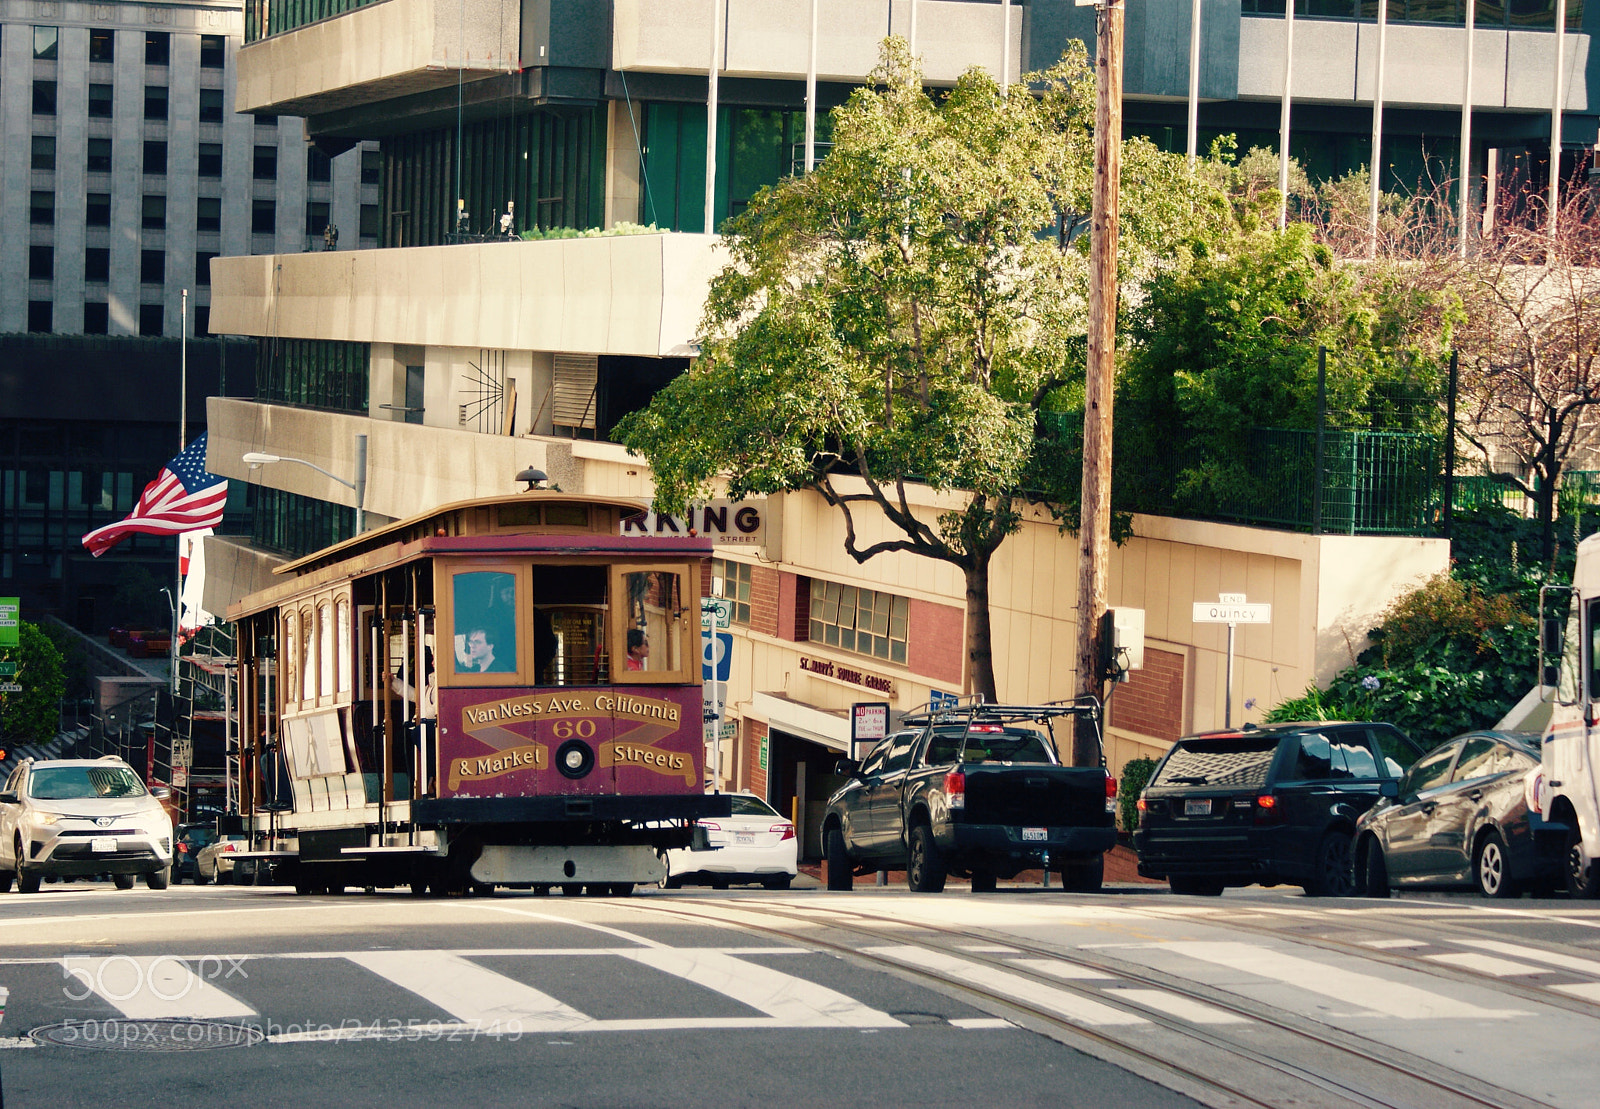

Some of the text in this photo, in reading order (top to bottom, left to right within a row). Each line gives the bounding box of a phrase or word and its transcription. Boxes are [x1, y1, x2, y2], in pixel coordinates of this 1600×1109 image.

[624, 507, 760, 533] RKING
[1209, 608, 1256, 619] Quincy
[837, 667, 862, 685] SQUARE
[865, 674, 892, 693] GARAGE
[466, 706, 499, 725] Van
[500, 699, 543, 719] Ness
[594, 695, 679, 722] California
[855, 706, 865, 715] NO
[552, 719, 597, 739] 60
[459, 745, 684, 776] & Market Streets
